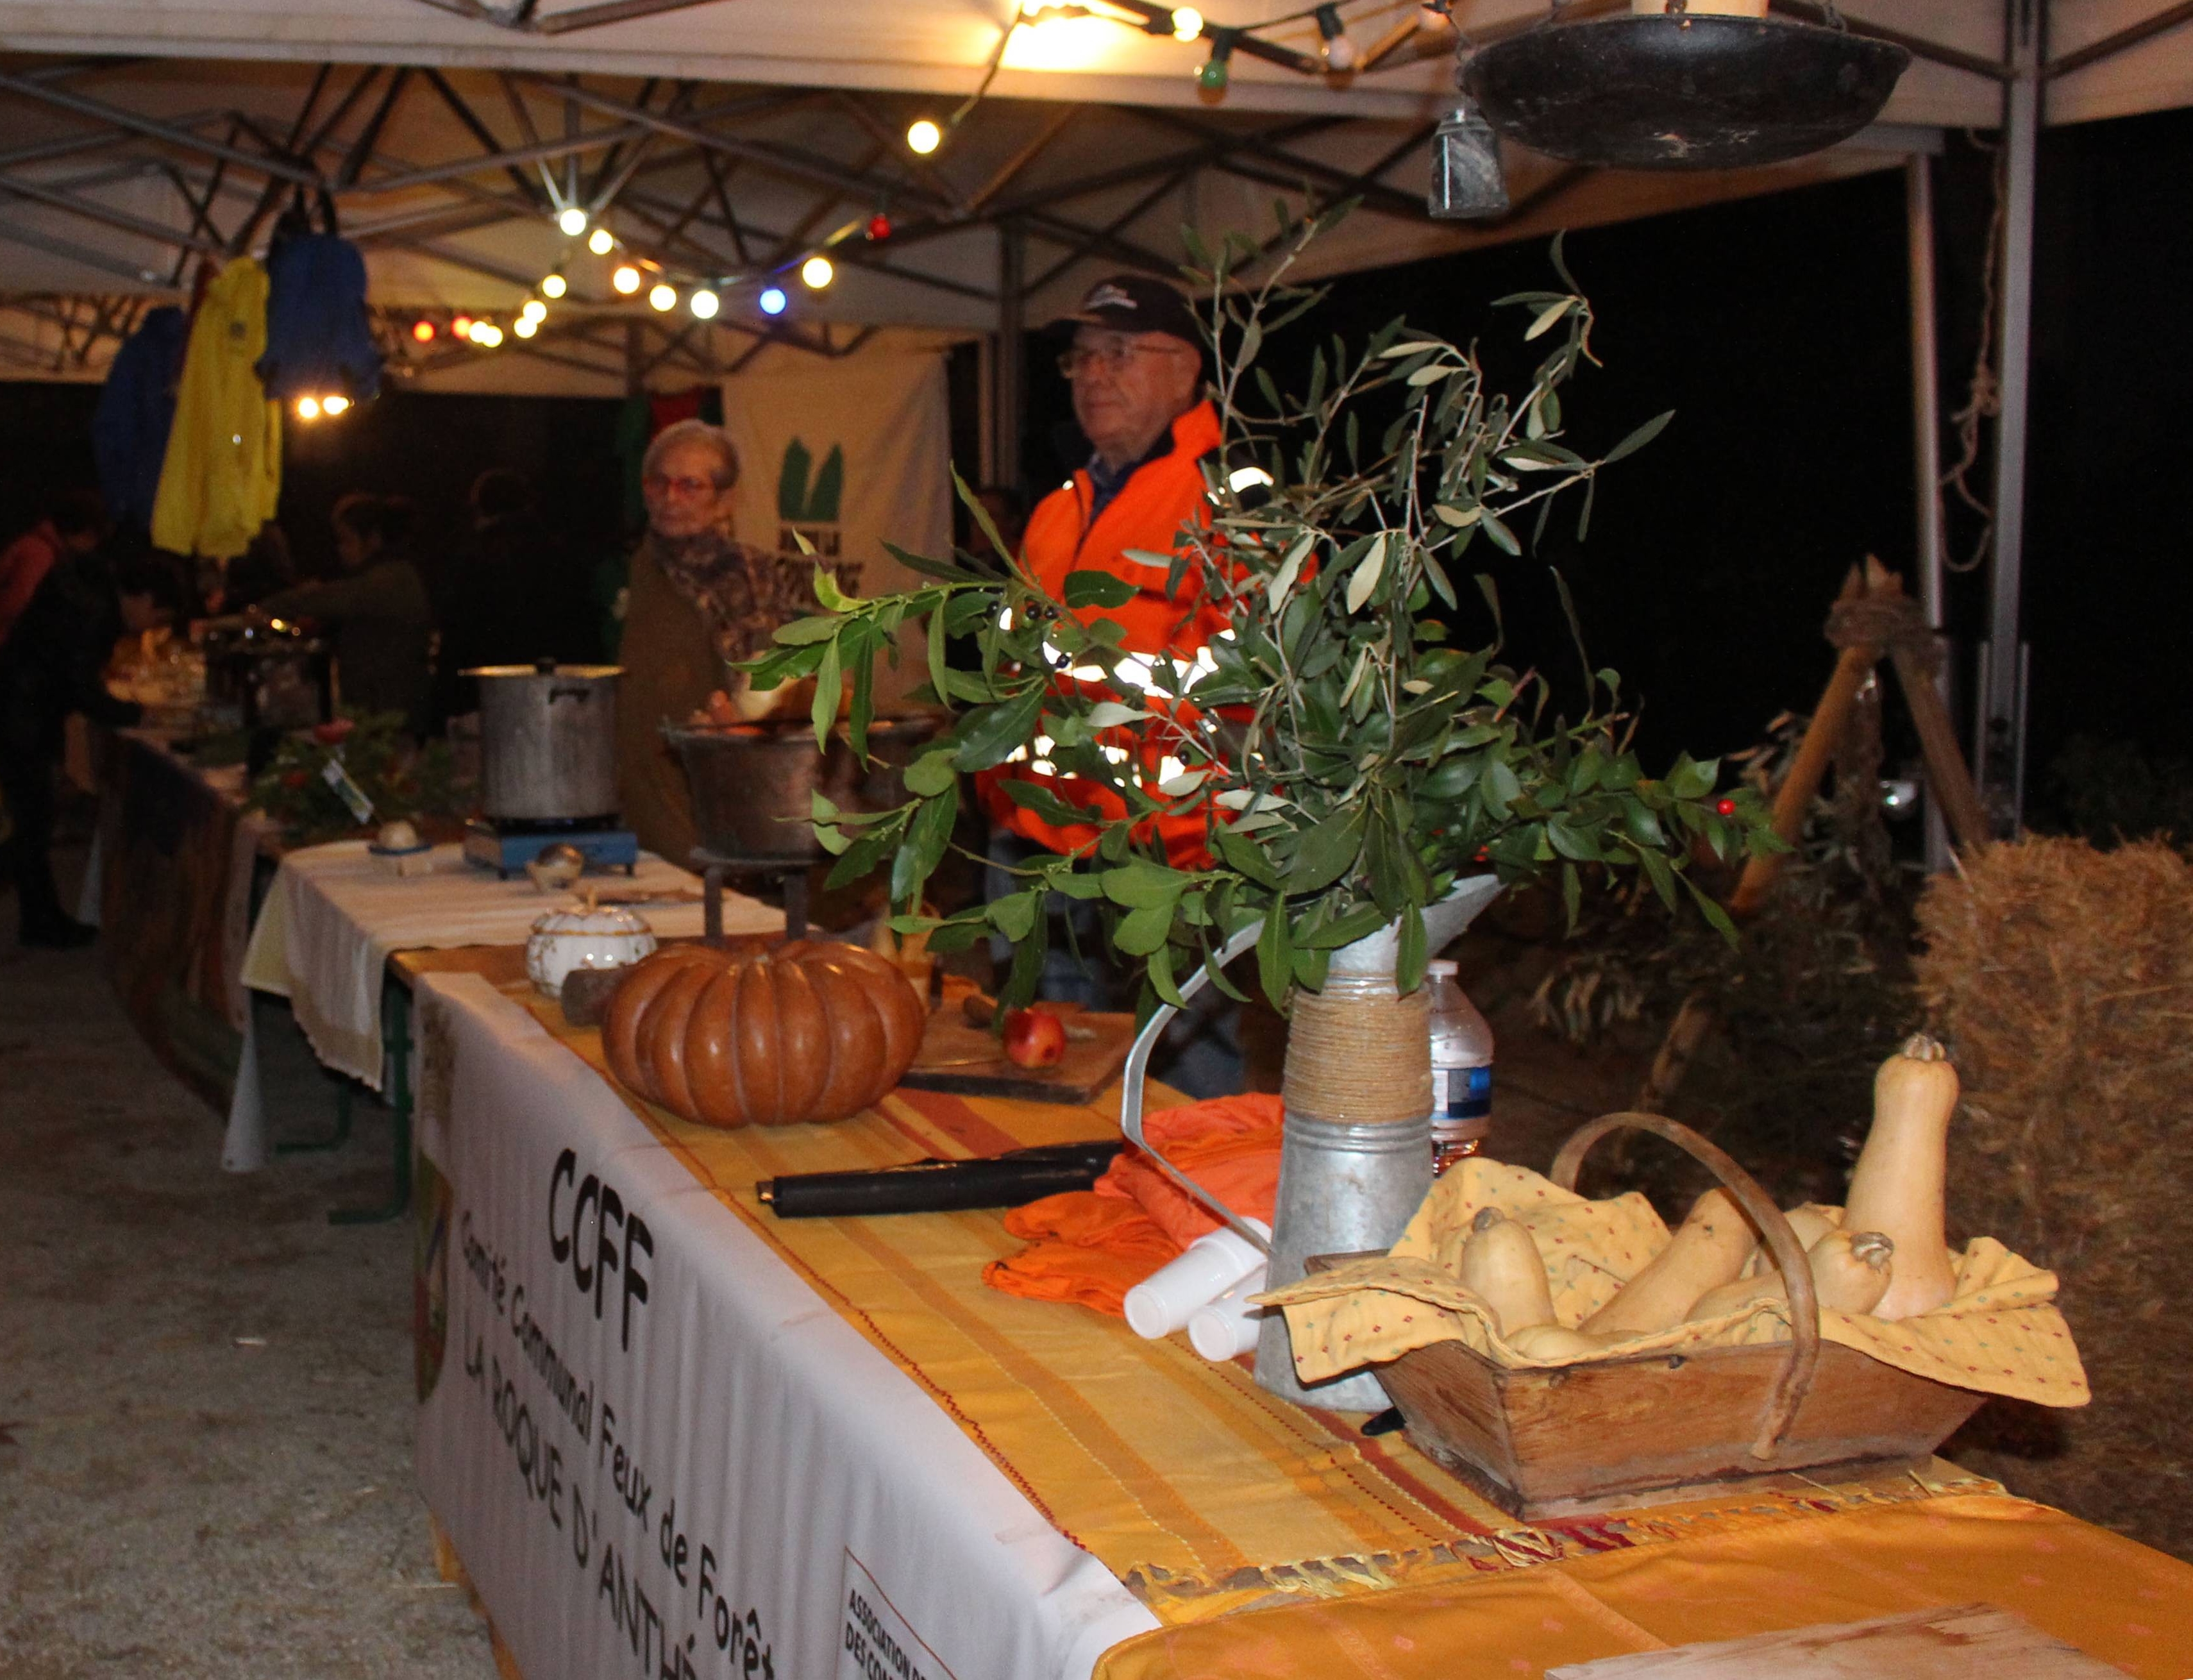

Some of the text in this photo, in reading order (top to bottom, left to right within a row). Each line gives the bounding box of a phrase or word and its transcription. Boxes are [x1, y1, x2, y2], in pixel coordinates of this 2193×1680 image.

[549, 1147, 653, 1353] CCFF
[464, 1305, 486, 1397] LA
[492, 1354, 563, 1530] ROQUE
[511, 1284, 594, 1445] Communal
[599, 1402, 652, 1534] Feux
[660, 1497, 688, 1589] de
[846, 1621, 866, 1668] DES
